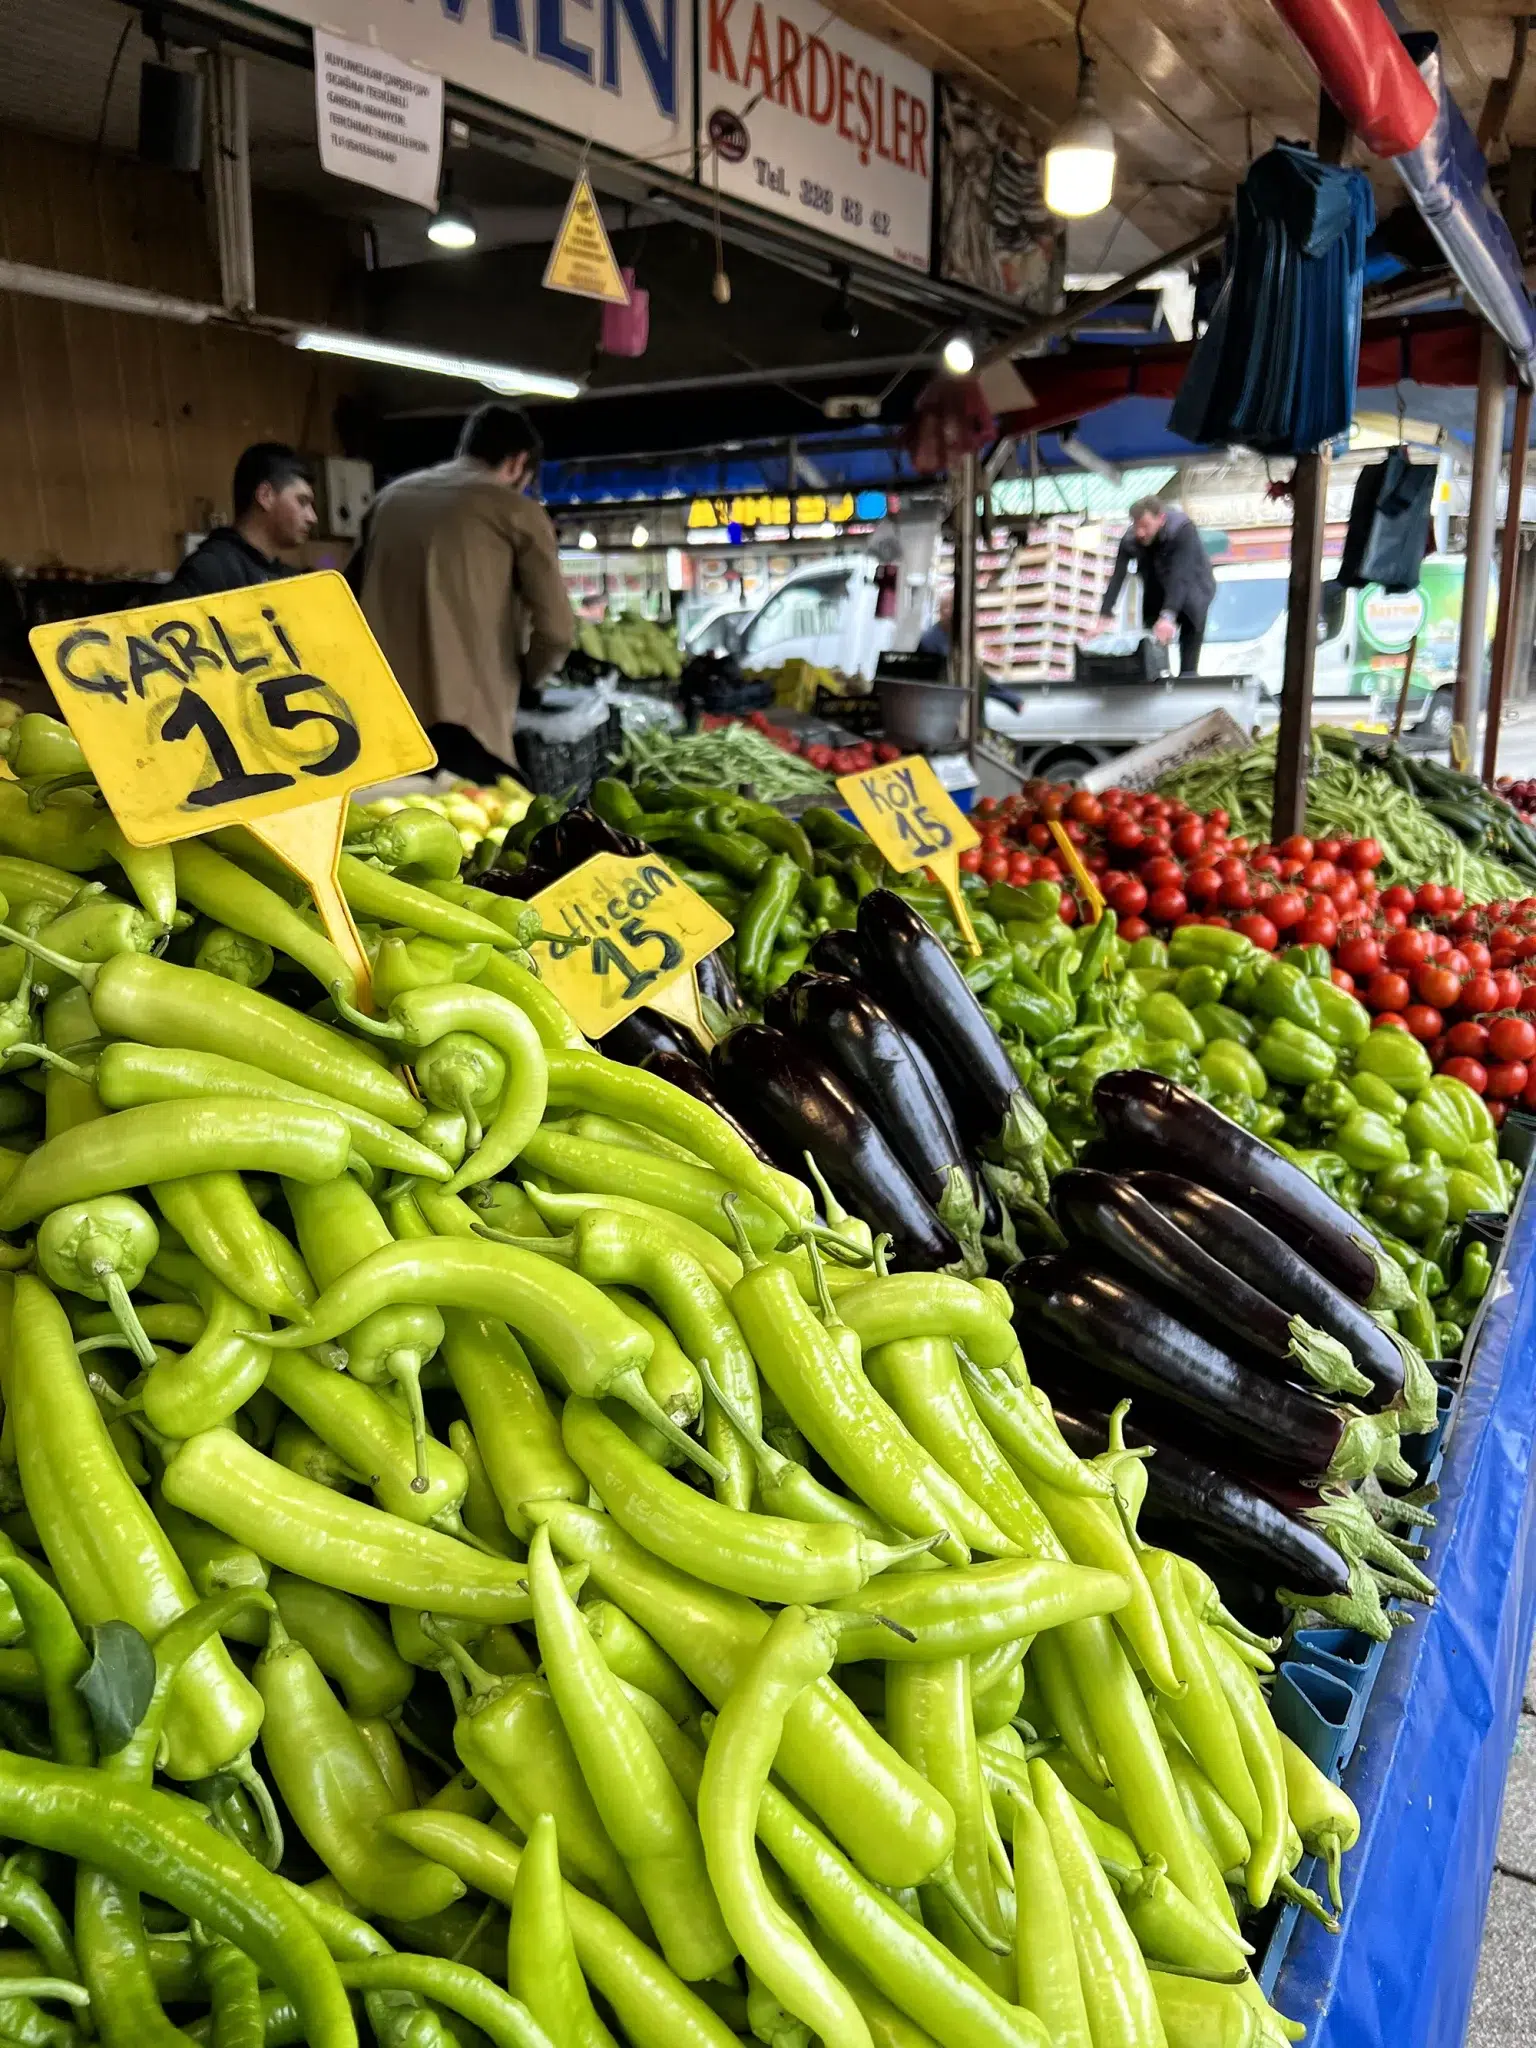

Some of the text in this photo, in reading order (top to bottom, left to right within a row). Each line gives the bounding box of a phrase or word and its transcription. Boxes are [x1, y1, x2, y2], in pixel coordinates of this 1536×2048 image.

[707, 0, 929, 177] KARDEŞLER
[753, 157, 791, 197] Tel.
[161, 674, 361, 807] 15
[896, 806, 953, 857] 15
[591, 917, 683, 1000] 15
